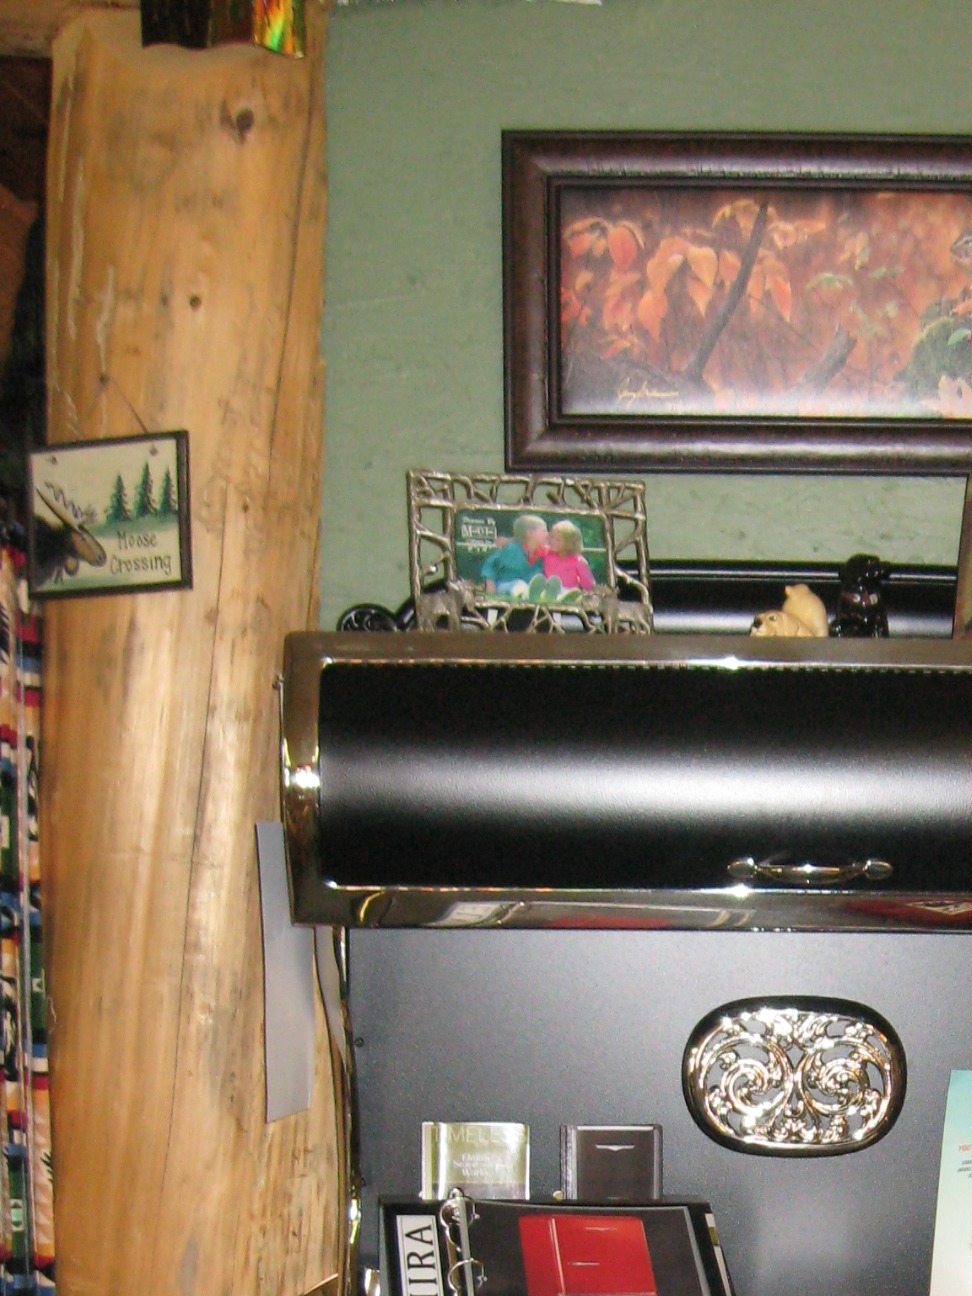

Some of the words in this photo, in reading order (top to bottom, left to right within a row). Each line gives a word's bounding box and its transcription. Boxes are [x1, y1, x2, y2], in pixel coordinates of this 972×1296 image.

[117, 531, 158, 550] Moose
[110, 554, 172, 576] Crossing
[958, 1144, 972, 1153] YOU
